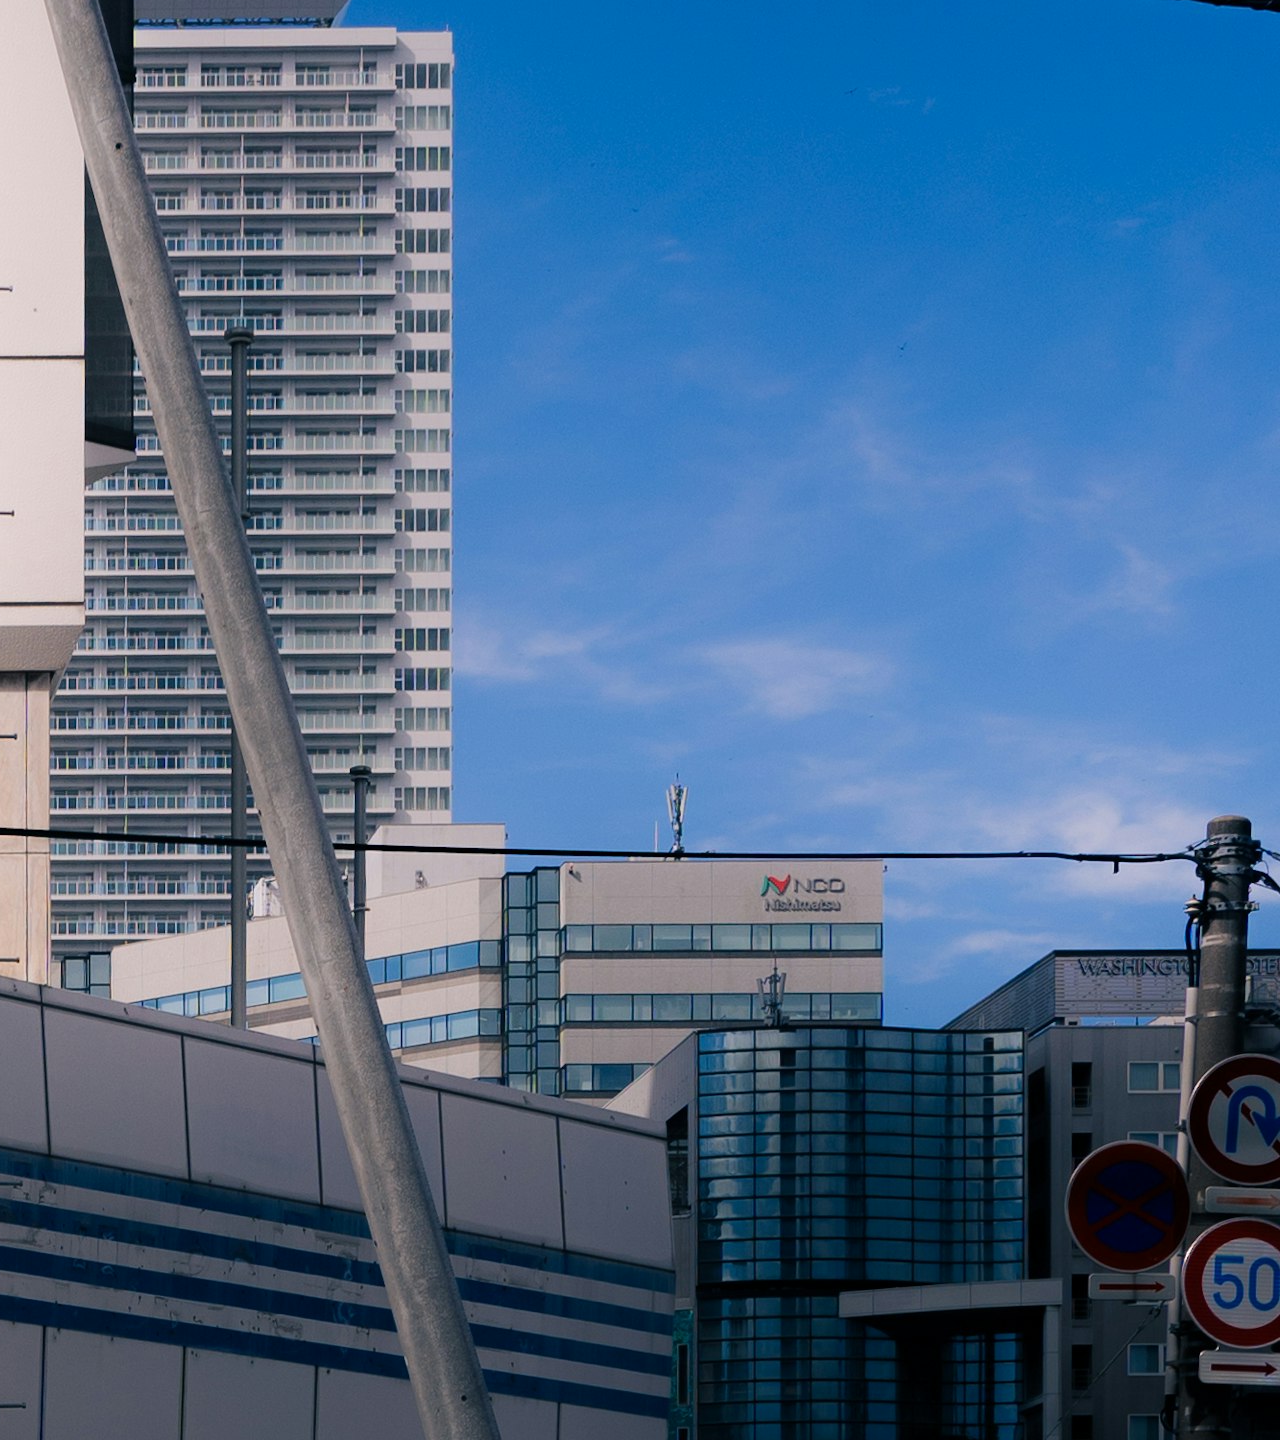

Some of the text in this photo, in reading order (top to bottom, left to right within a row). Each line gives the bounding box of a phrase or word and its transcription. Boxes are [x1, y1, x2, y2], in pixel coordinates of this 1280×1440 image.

[765, 898, 841, 912] Nishimatsu
[1078, 958, 1197, 976] WASHINGTO
[1213, 1254, 1280, 1311] 50
